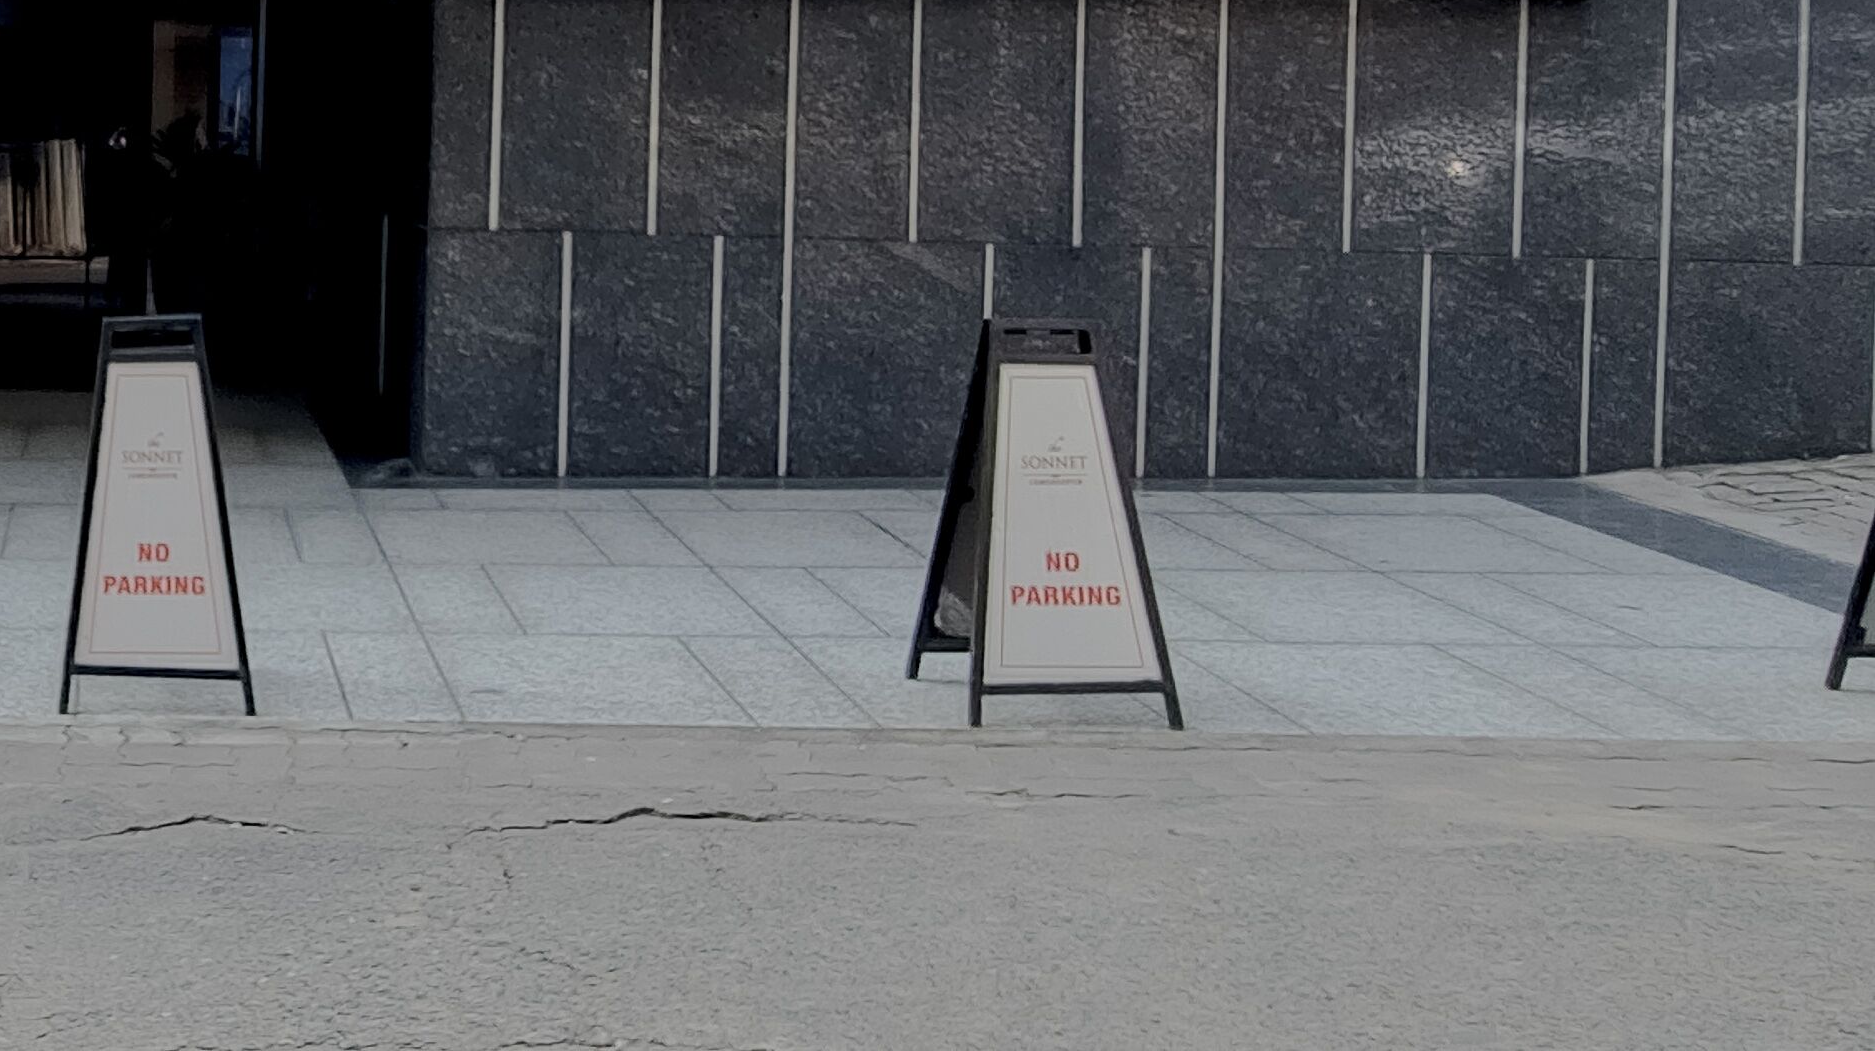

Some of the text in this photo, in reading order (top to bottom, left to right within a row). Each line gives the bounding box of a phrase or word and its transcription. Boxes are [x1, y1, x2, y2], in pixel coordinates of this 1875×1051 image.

[121, 450, 183, 464] SONNET
[1021, 455, 1087, 469] SONNET
[137, 543, 171, 563] NO
[1045, 551, 1081, 572] NO
[102, 575, 206, 596] PARKING
[1010, 585, 1122, 606] PARKING
